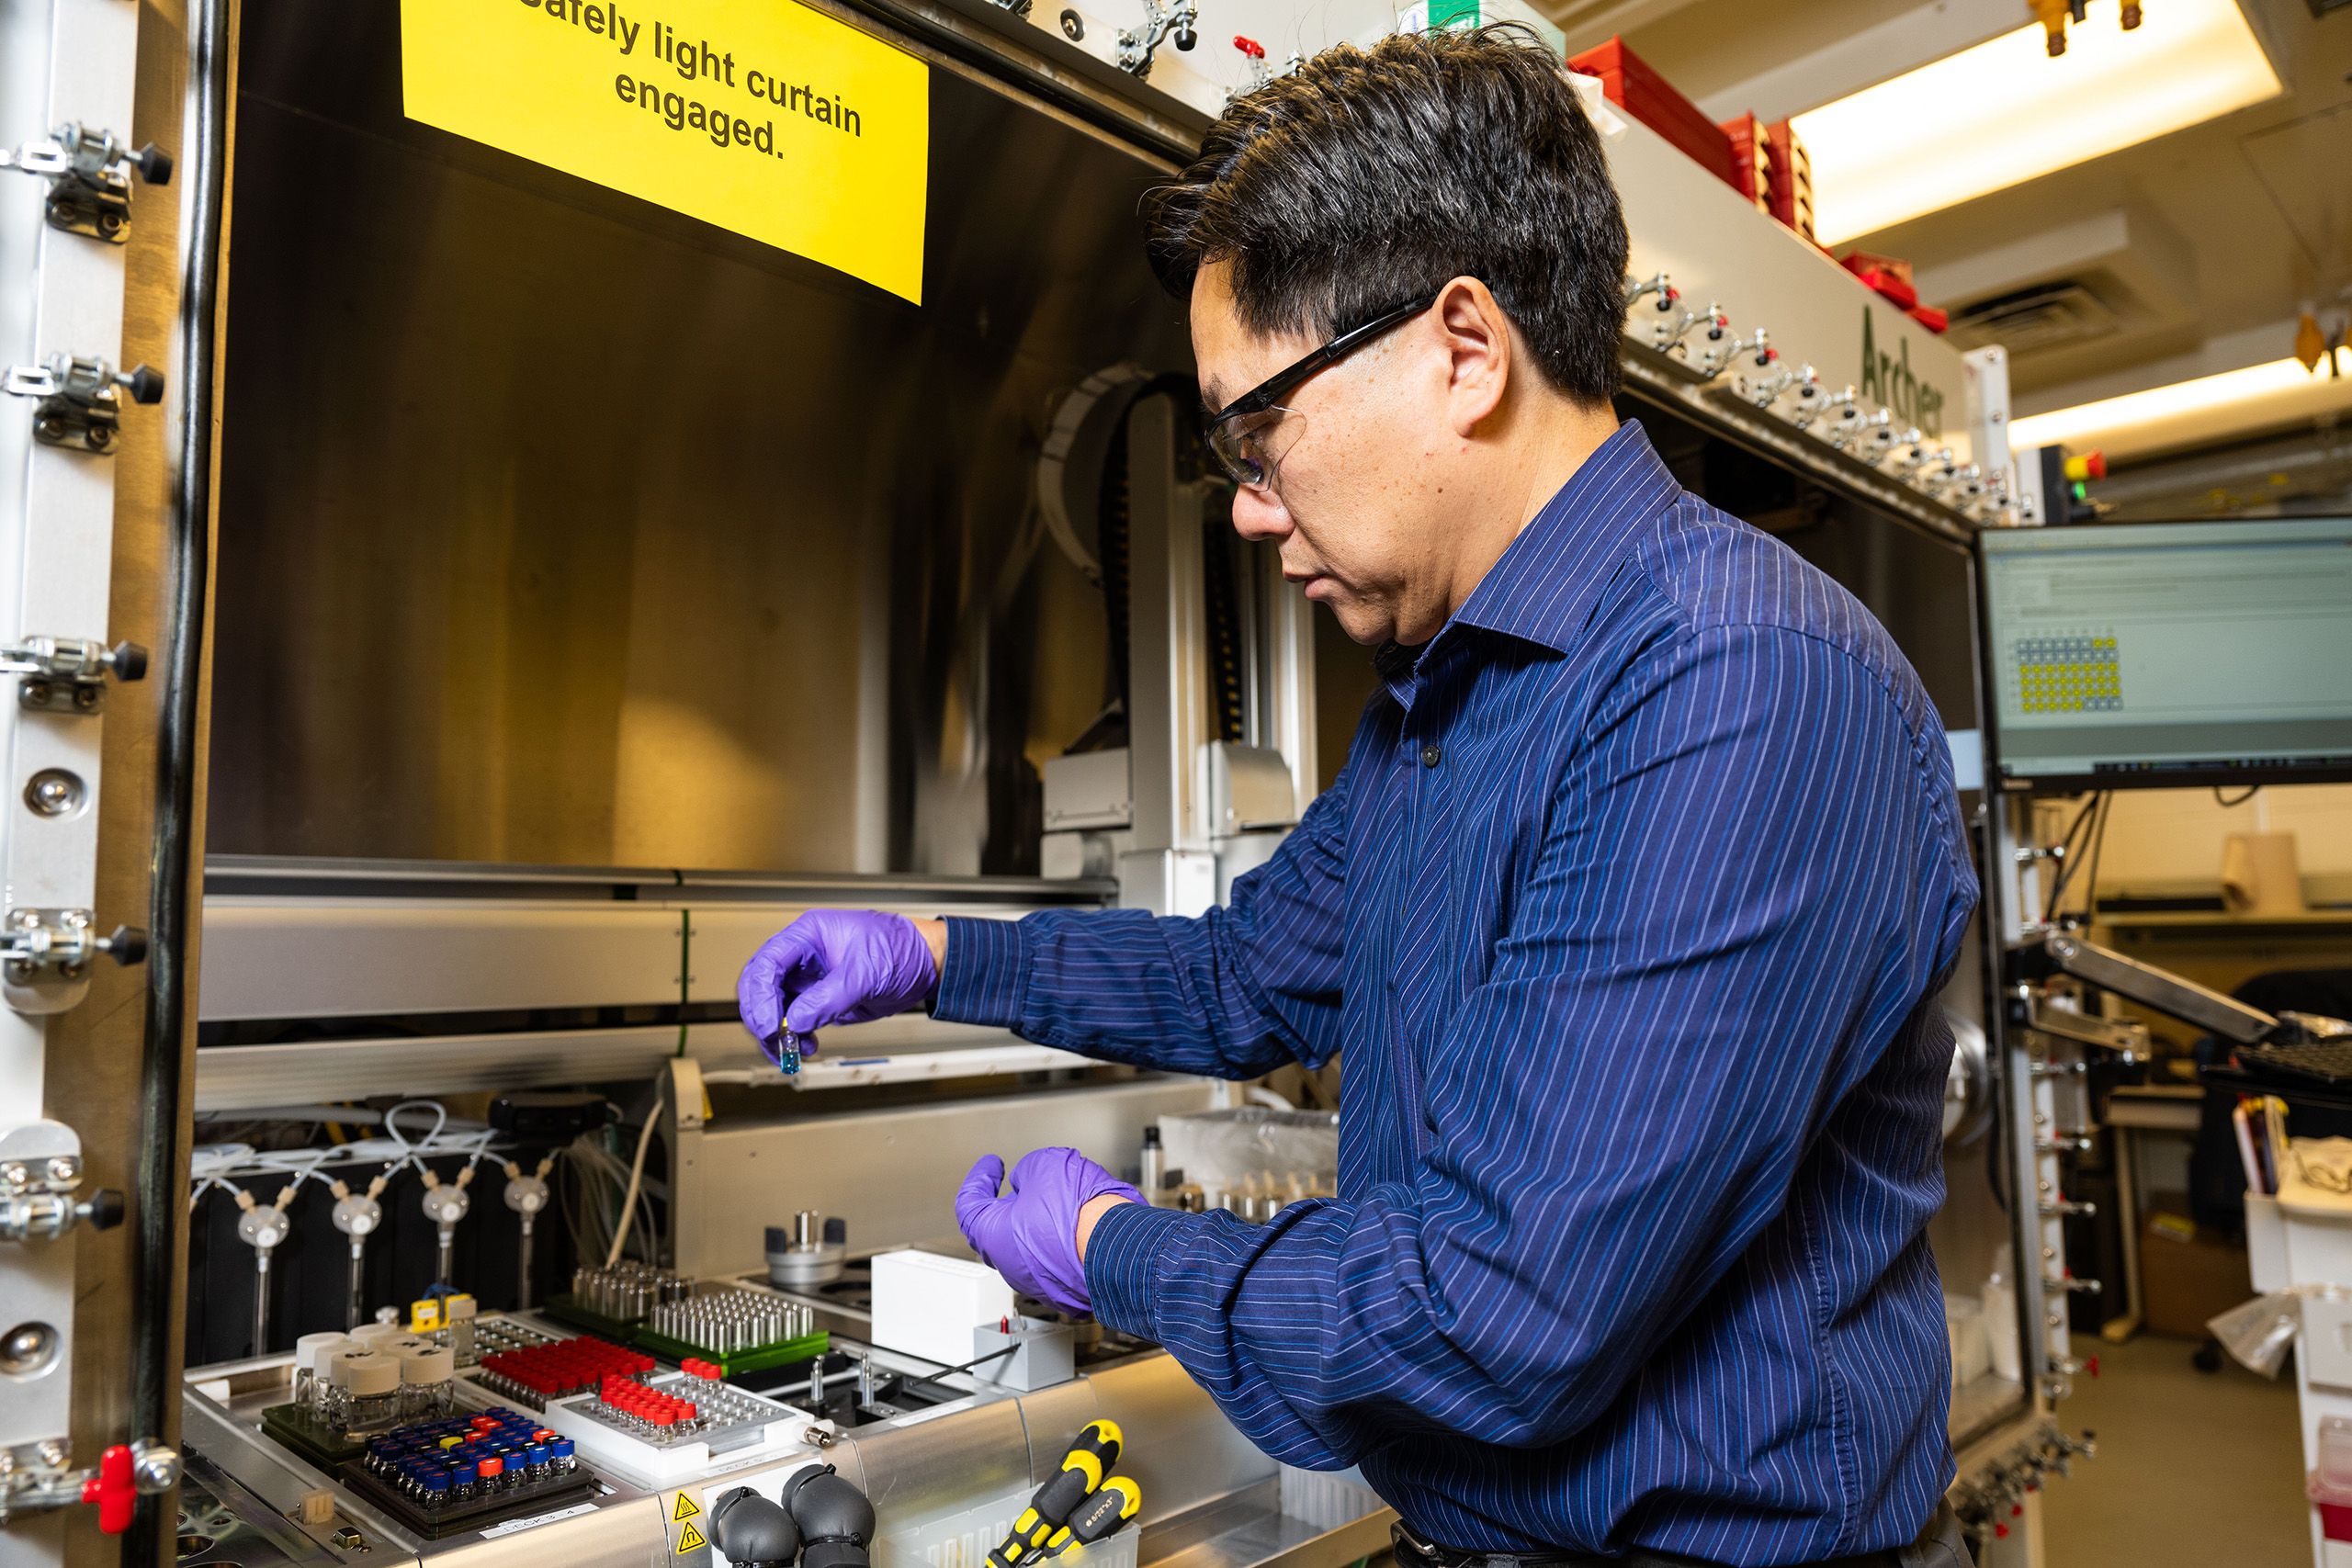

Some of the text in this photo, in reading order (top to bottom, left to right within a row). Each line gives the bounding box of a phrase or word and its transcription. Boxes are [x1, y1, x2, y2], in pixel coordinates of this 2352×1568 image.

[520, 0, 862, 138] afely light curtain
[615, 72, 785, 160] engaged.
[1861, 303, 1943, 441] Archer
